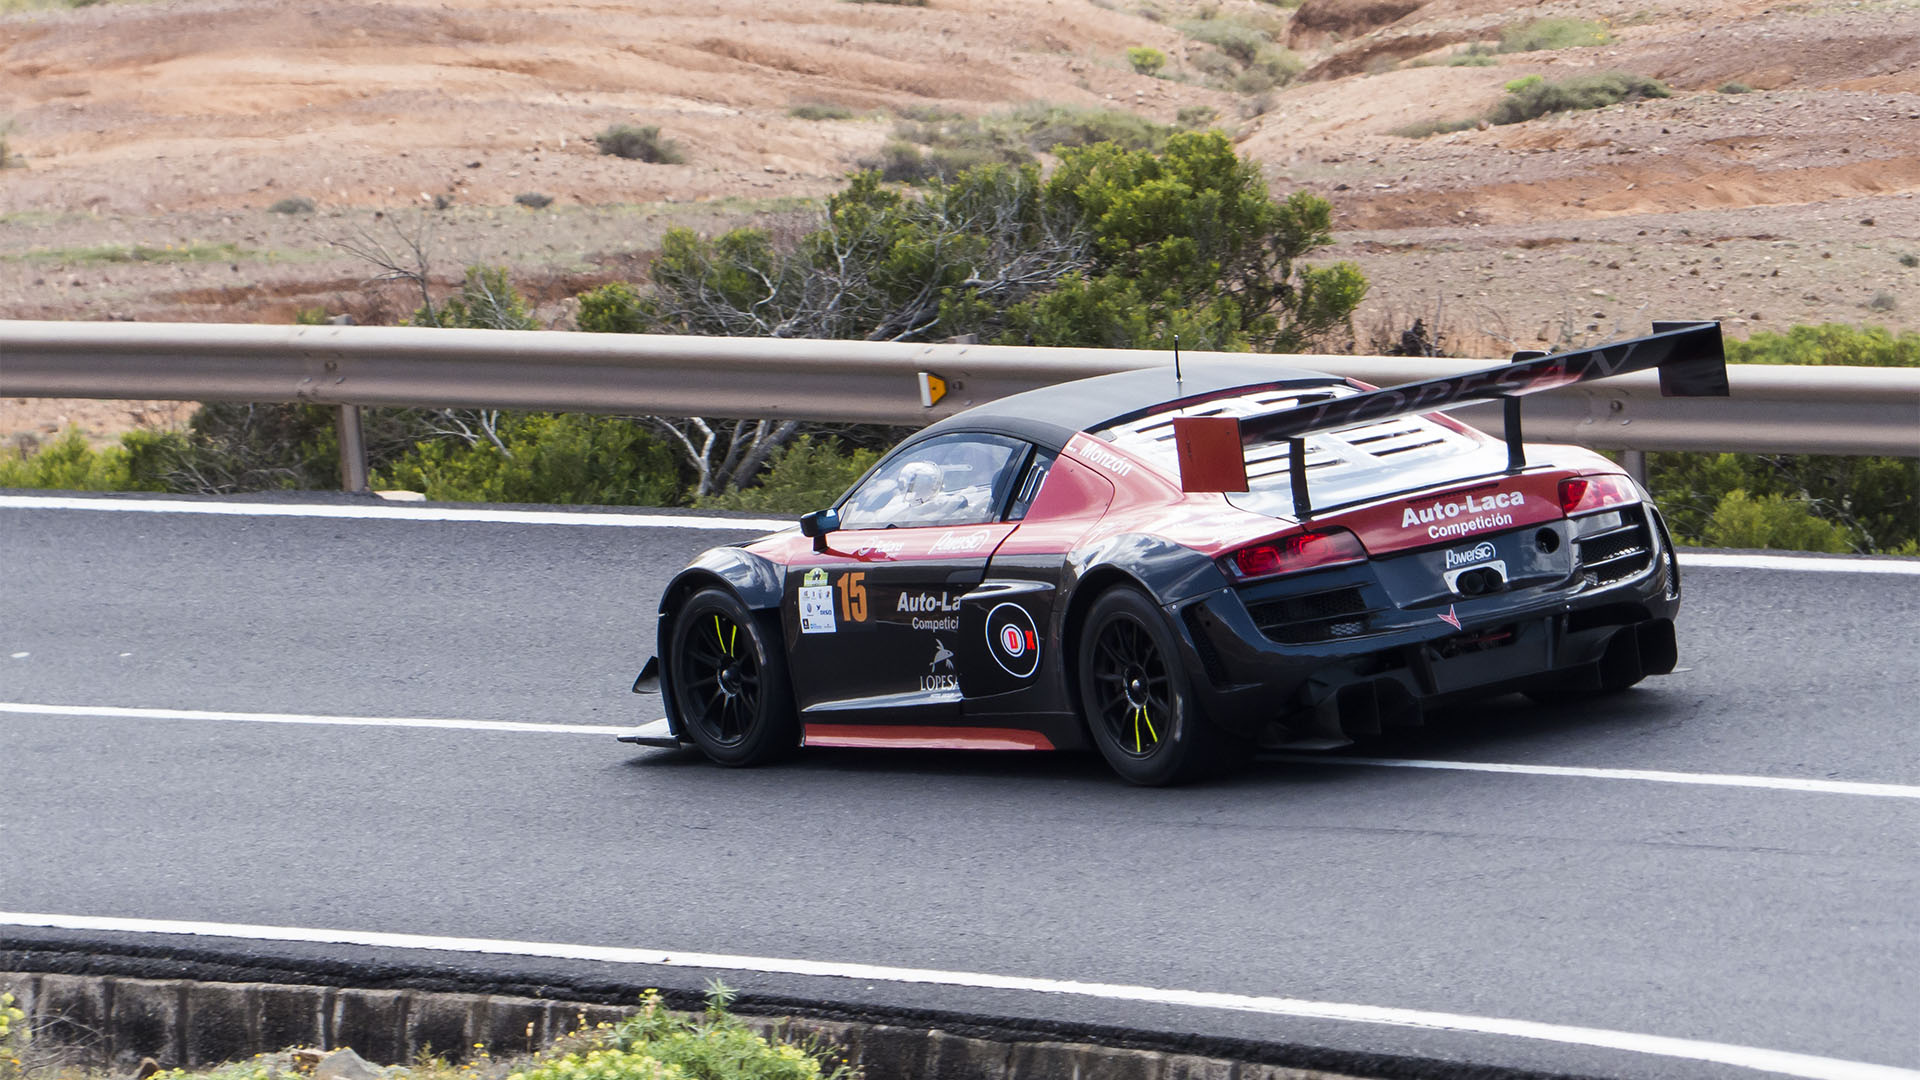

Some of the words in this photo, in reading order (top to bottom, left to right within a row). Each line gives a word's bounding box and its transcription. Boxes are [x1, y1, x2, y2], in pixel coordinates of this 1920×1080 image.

[1401, 491, 1525, 528] Auto-Laca
[1427, 512, 1513, 539] Competición
[837, 572, 867, 622] 15
[911, 616, 960, 633] Competici
